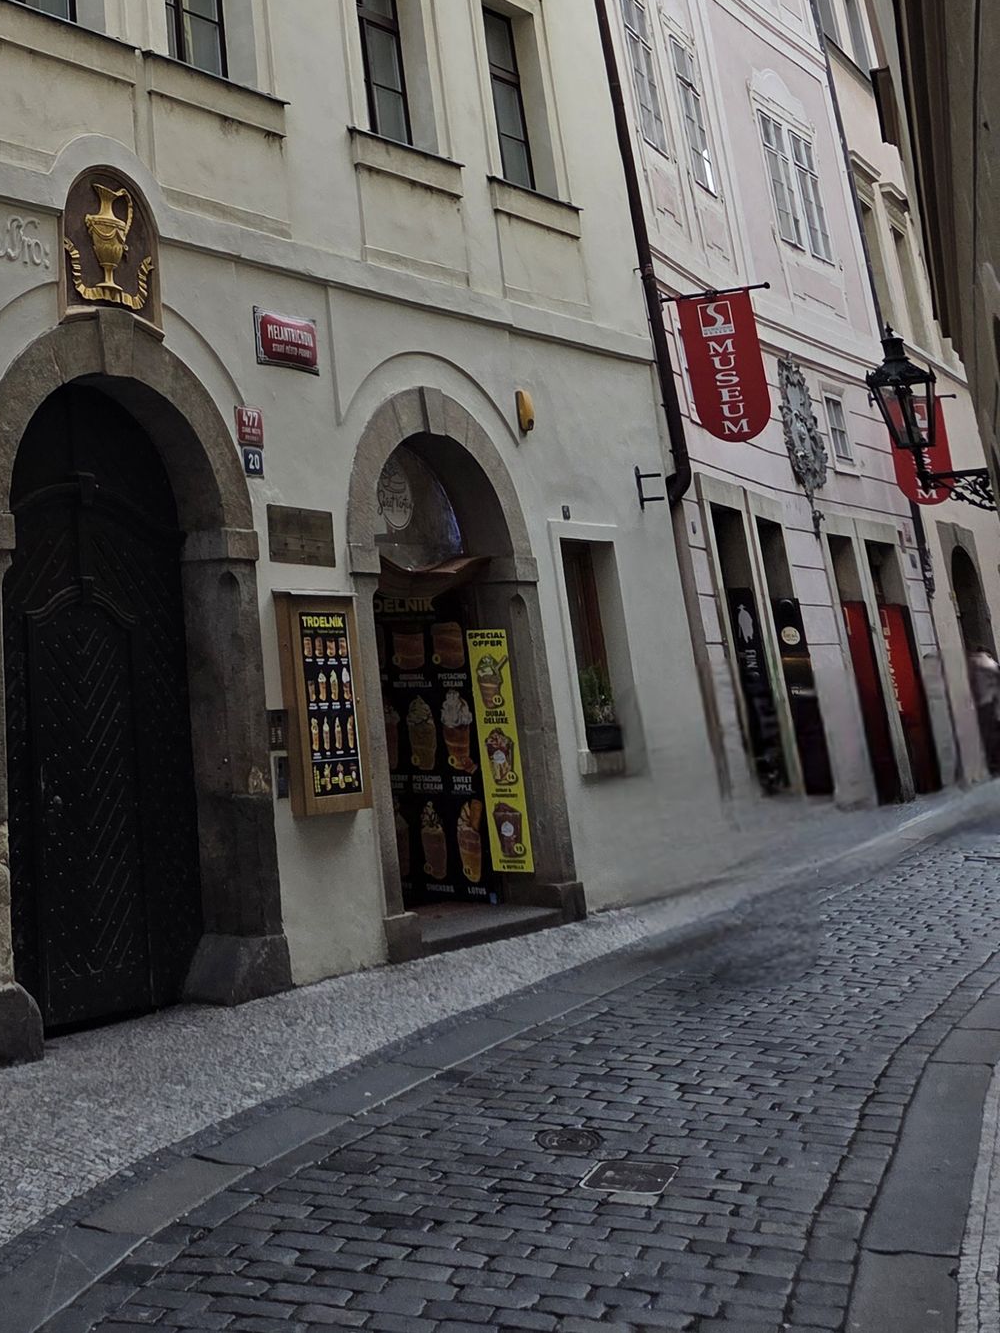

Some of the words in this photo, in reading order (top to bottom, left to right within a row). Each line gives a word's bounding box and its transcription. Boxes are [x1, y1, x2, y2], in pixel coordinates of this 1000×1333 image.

[708, 338, 752, 436] MUSEUM
[242, 410, 259, 427] 477
[248, 453, 260, 470] 20
[301, 615, 344, 628] TRDELNÍK
